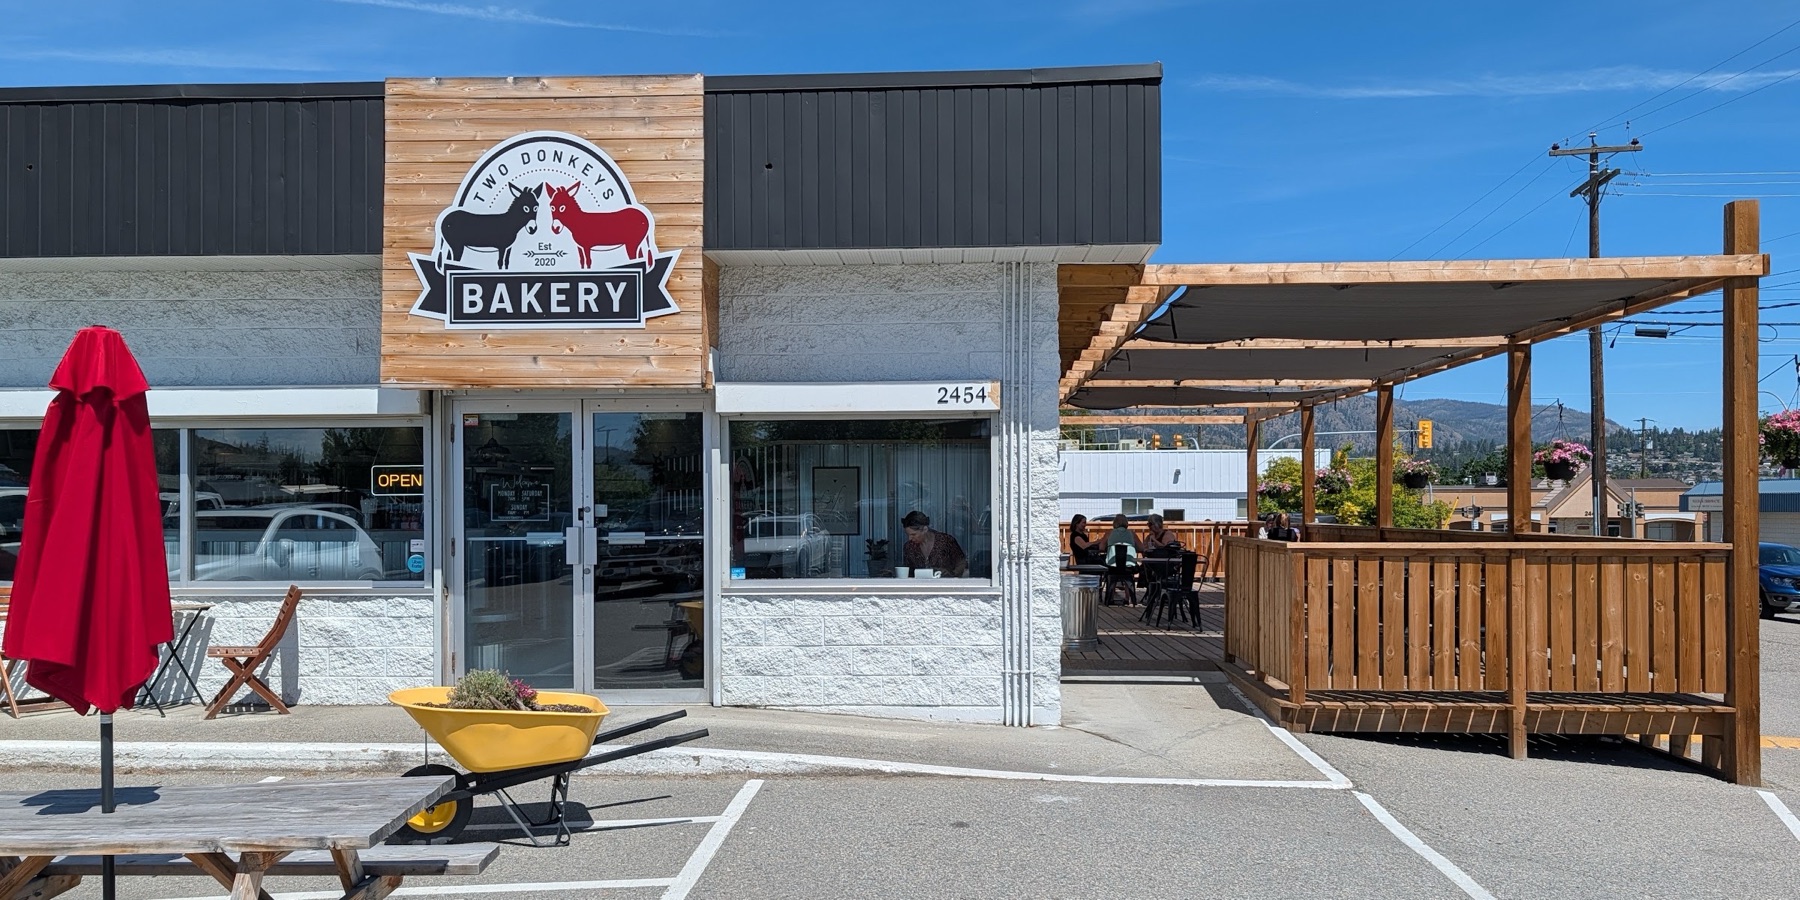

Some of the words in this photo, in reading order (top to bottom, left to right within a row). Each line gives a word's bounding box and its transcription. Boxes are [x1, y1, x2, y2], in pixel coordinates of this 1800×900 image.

[473, 163, 509, 204] TWO
[521, 149, 615, 201] DONKEYS
[538, 242, 553, 251] Est
[534, 258, 556, 267] 2020
[462, 281, 628, 314] BAKERY
[937, 386, 987, 404] 2454
[378, 474, 422, 487] OPEN
[500, 474, 540, 489] Welcome
